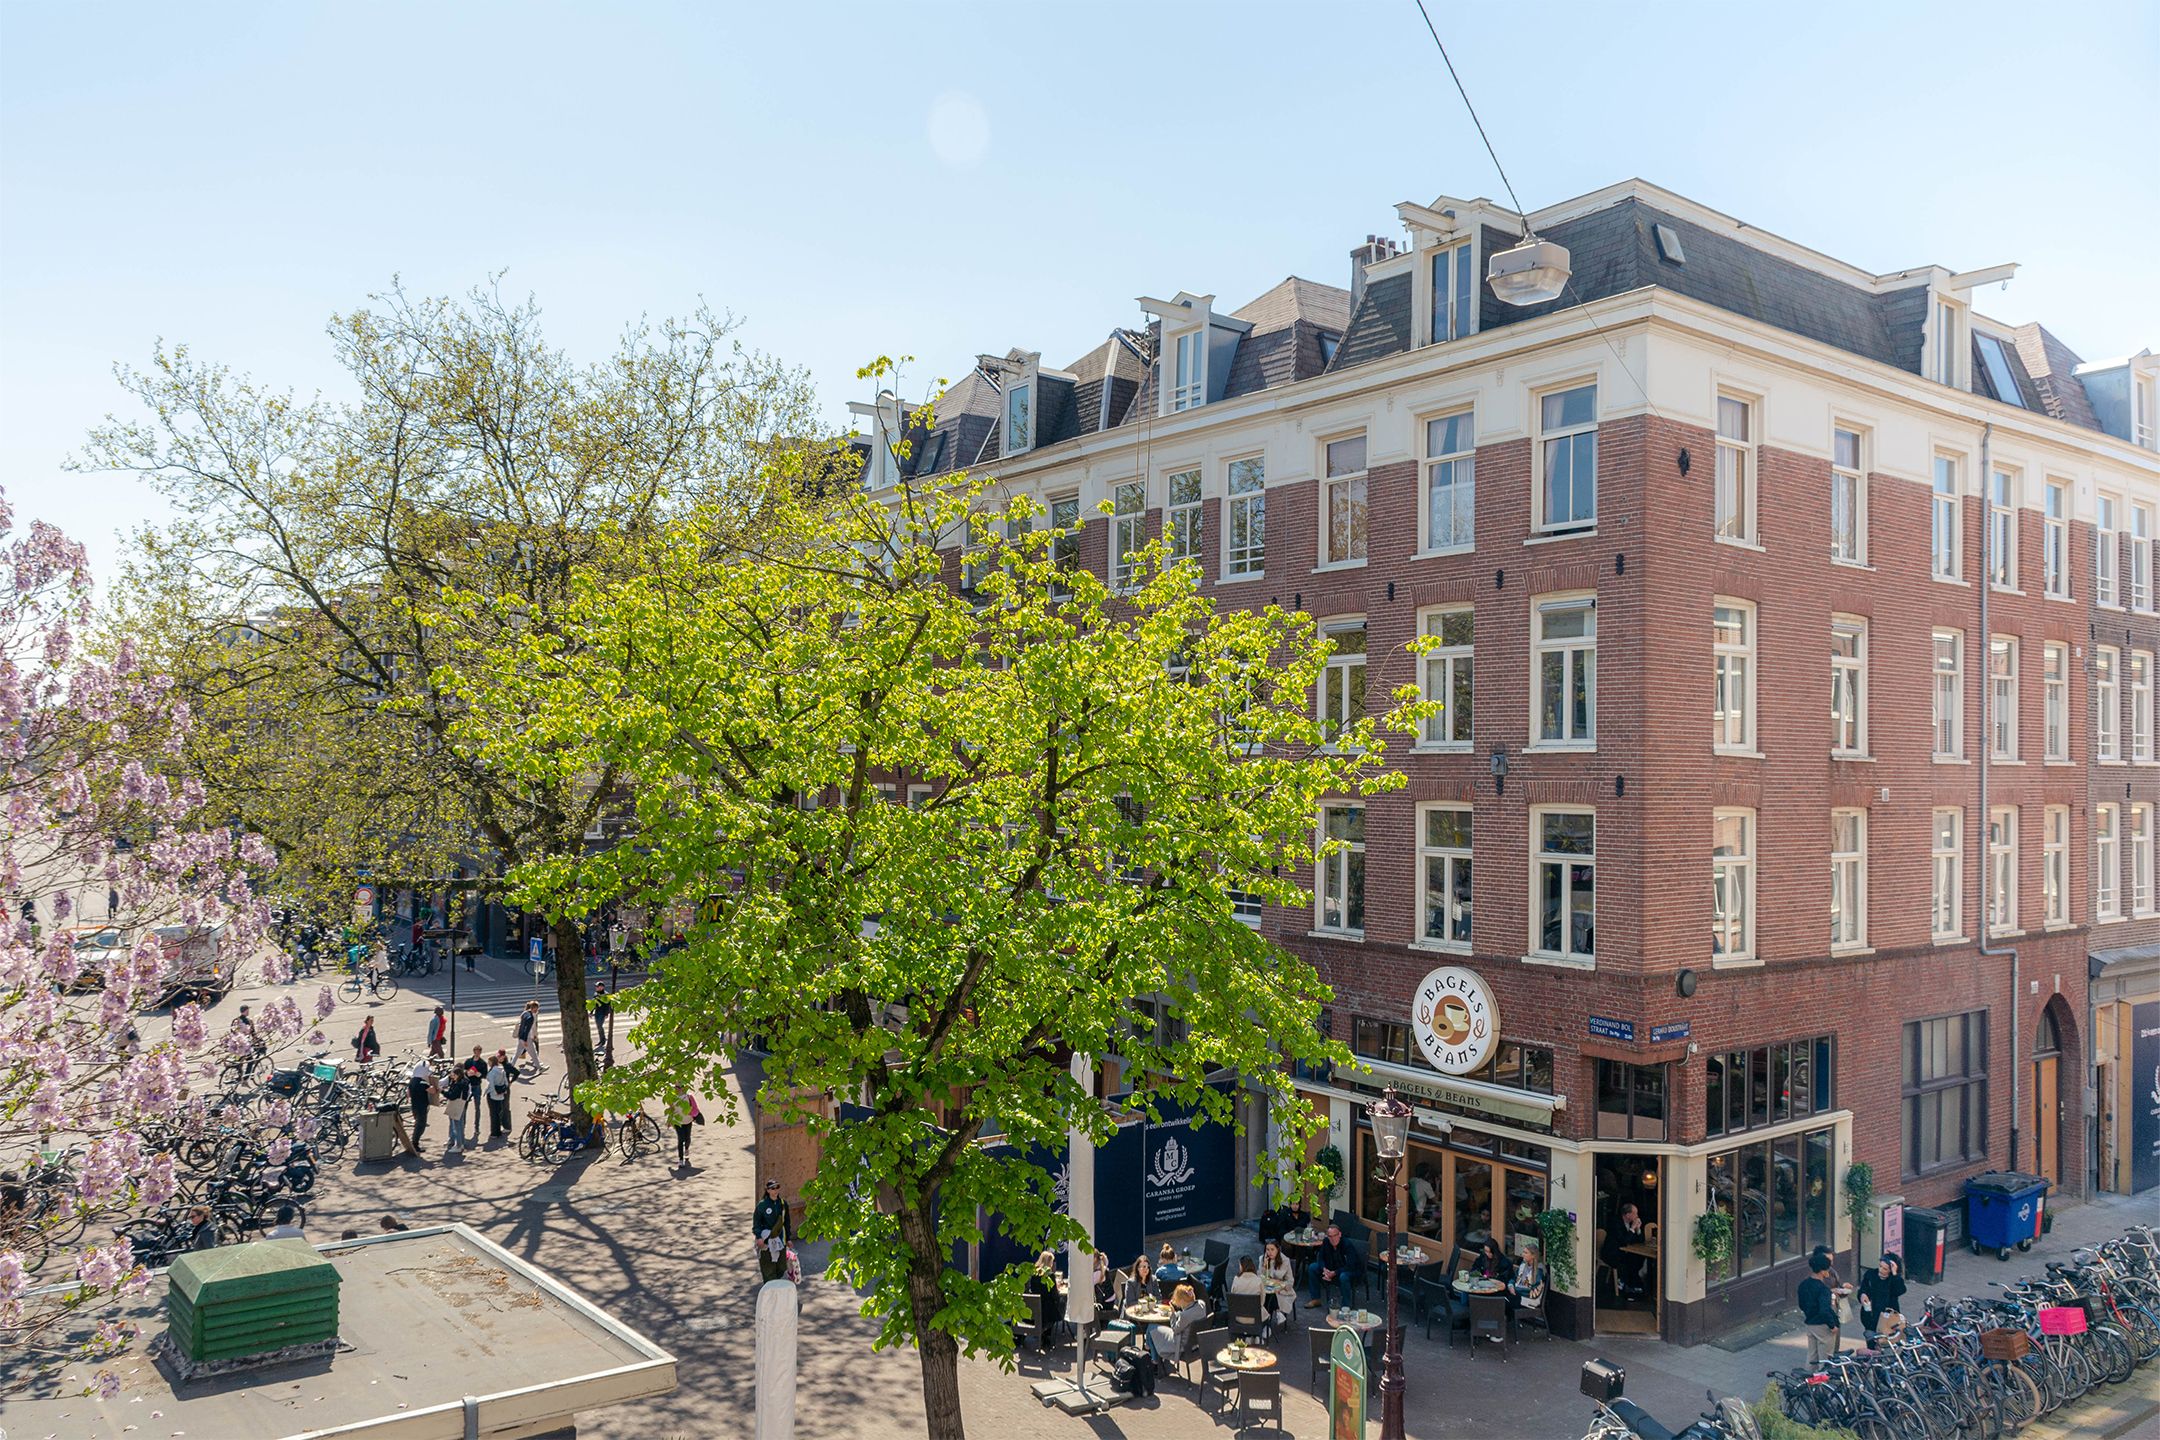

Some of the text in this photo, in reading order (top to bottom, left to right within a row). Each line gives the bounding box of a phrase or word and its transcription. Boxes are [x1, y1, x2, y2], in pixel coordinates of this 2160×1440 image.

[1424, 975, 1483, 1013] BAGELS
[1590, 1025, 1608, 1034] STRAAT
[1621, 1023, 1631, 1031] BOL
[1424, 1034, 1478, 1065] BEANS
[1393, 1080, 1481, 1106] BAGELS & BEANS
[1166, 1152, 1174, 1160] M
[1146, 1185, 1195, 1198] CARANSA GROEP
